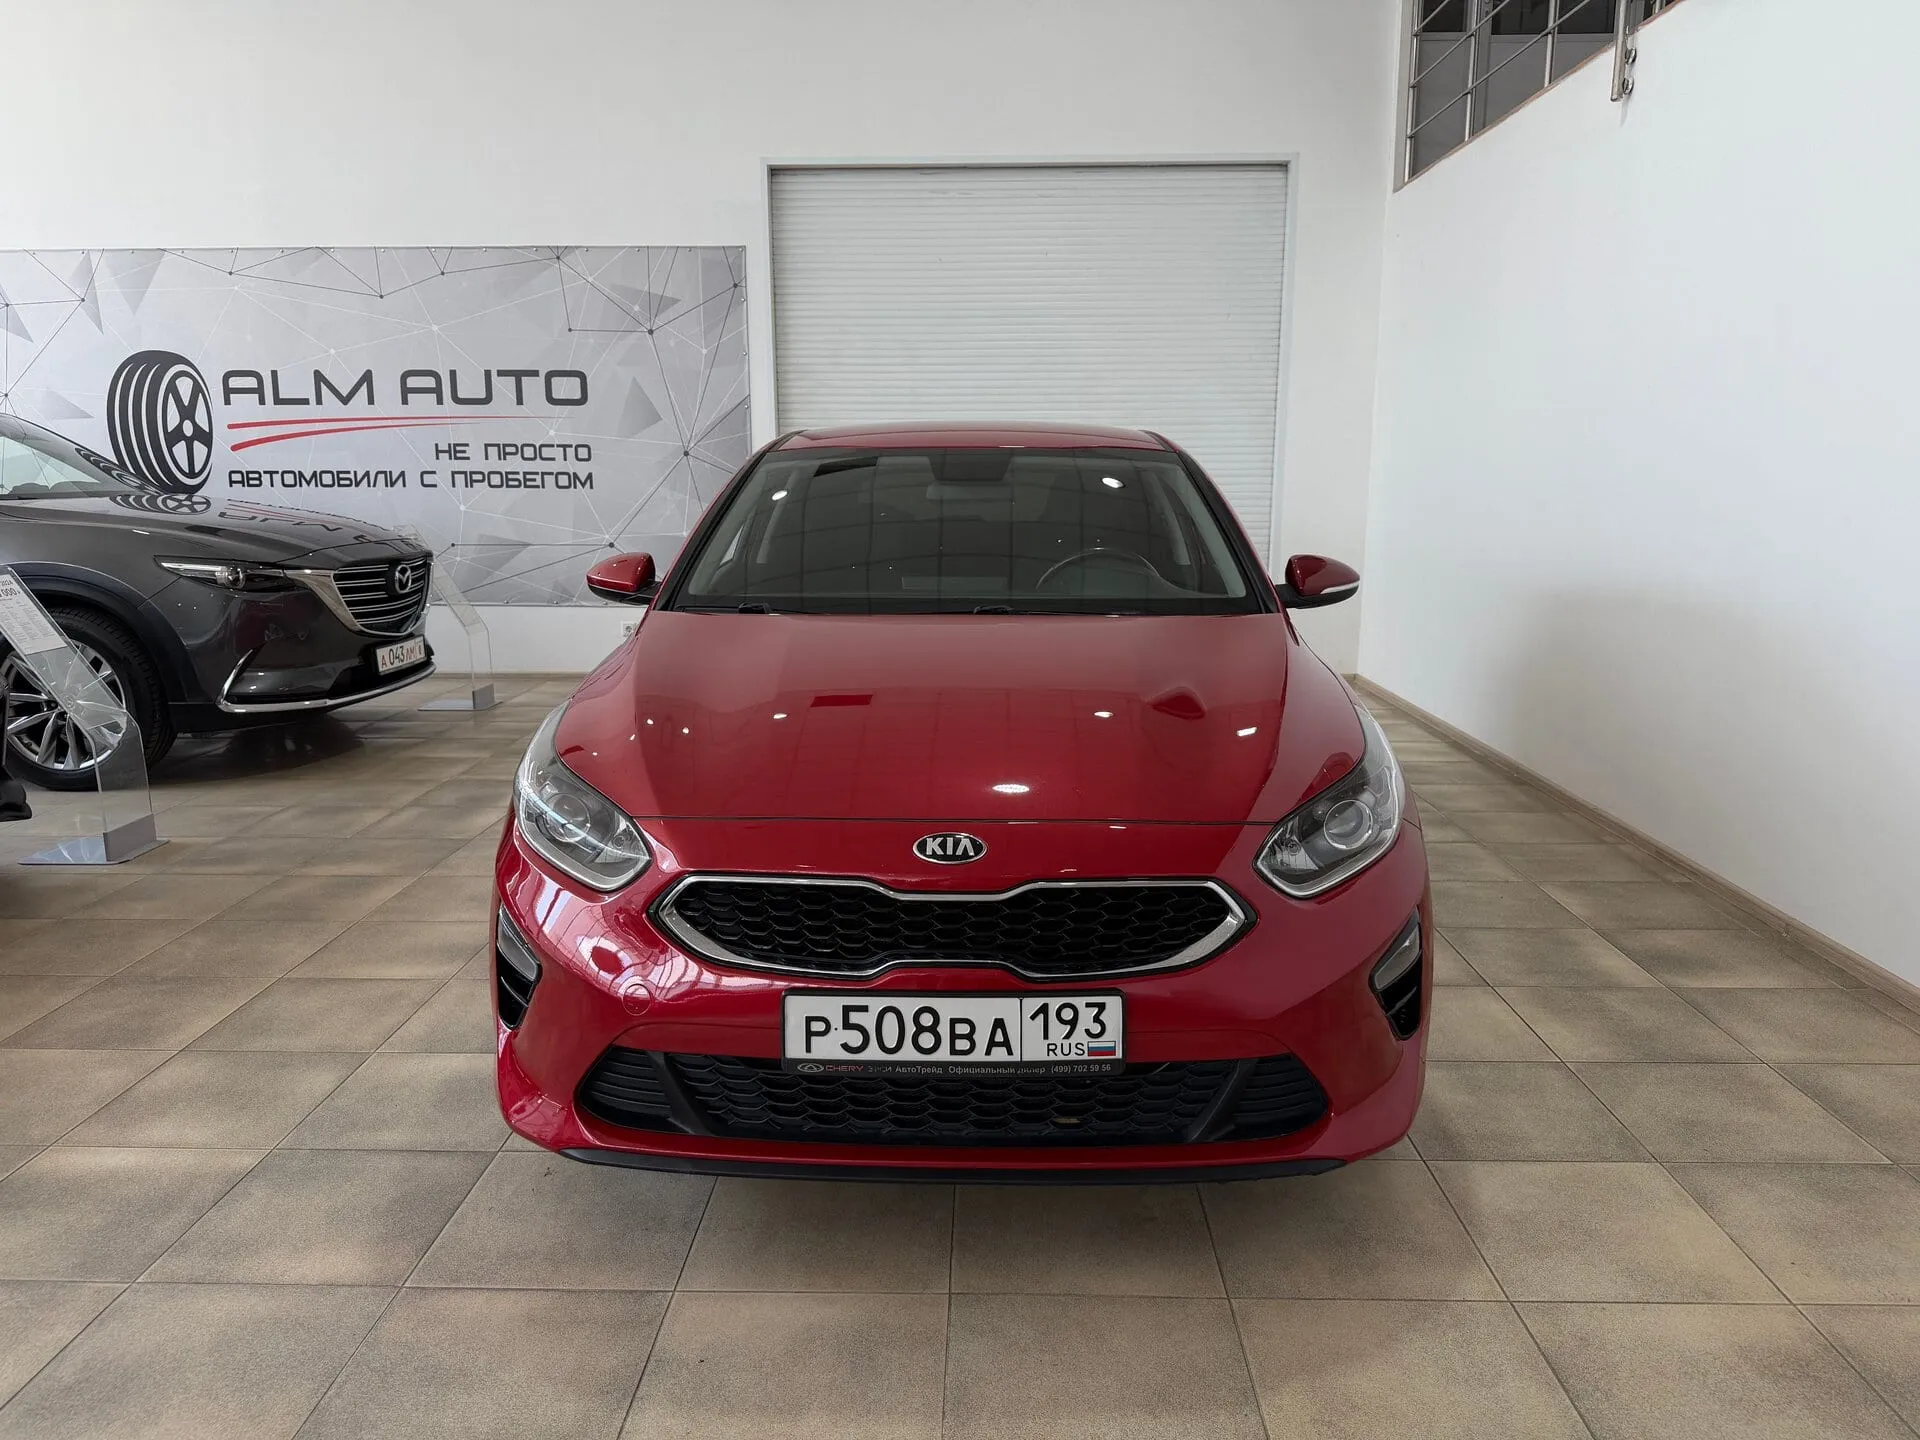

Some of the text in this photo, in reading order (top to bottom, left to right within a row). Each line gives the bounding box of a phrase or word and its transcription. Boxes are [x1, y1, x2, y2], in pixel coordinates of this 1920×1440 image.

[222, 369, 589, 406] ALM AUTO
[435, 442, 593, 462] НЕ ПРОСТО
[228, 470, 594, 490] АВТОМОБИЛИ С ПРОБЕГОМ
[926, 837, 975, 856] KIA
[1028, 1002, 1107, 1041] 193
[1046, 1041, 1086, 1057] RUS
[895, 1065, 943, 1075] АвтоТрейд
[1051, 1064, 1072, 1074] (499)
[1073, 1064, 1088, 1073] 702
